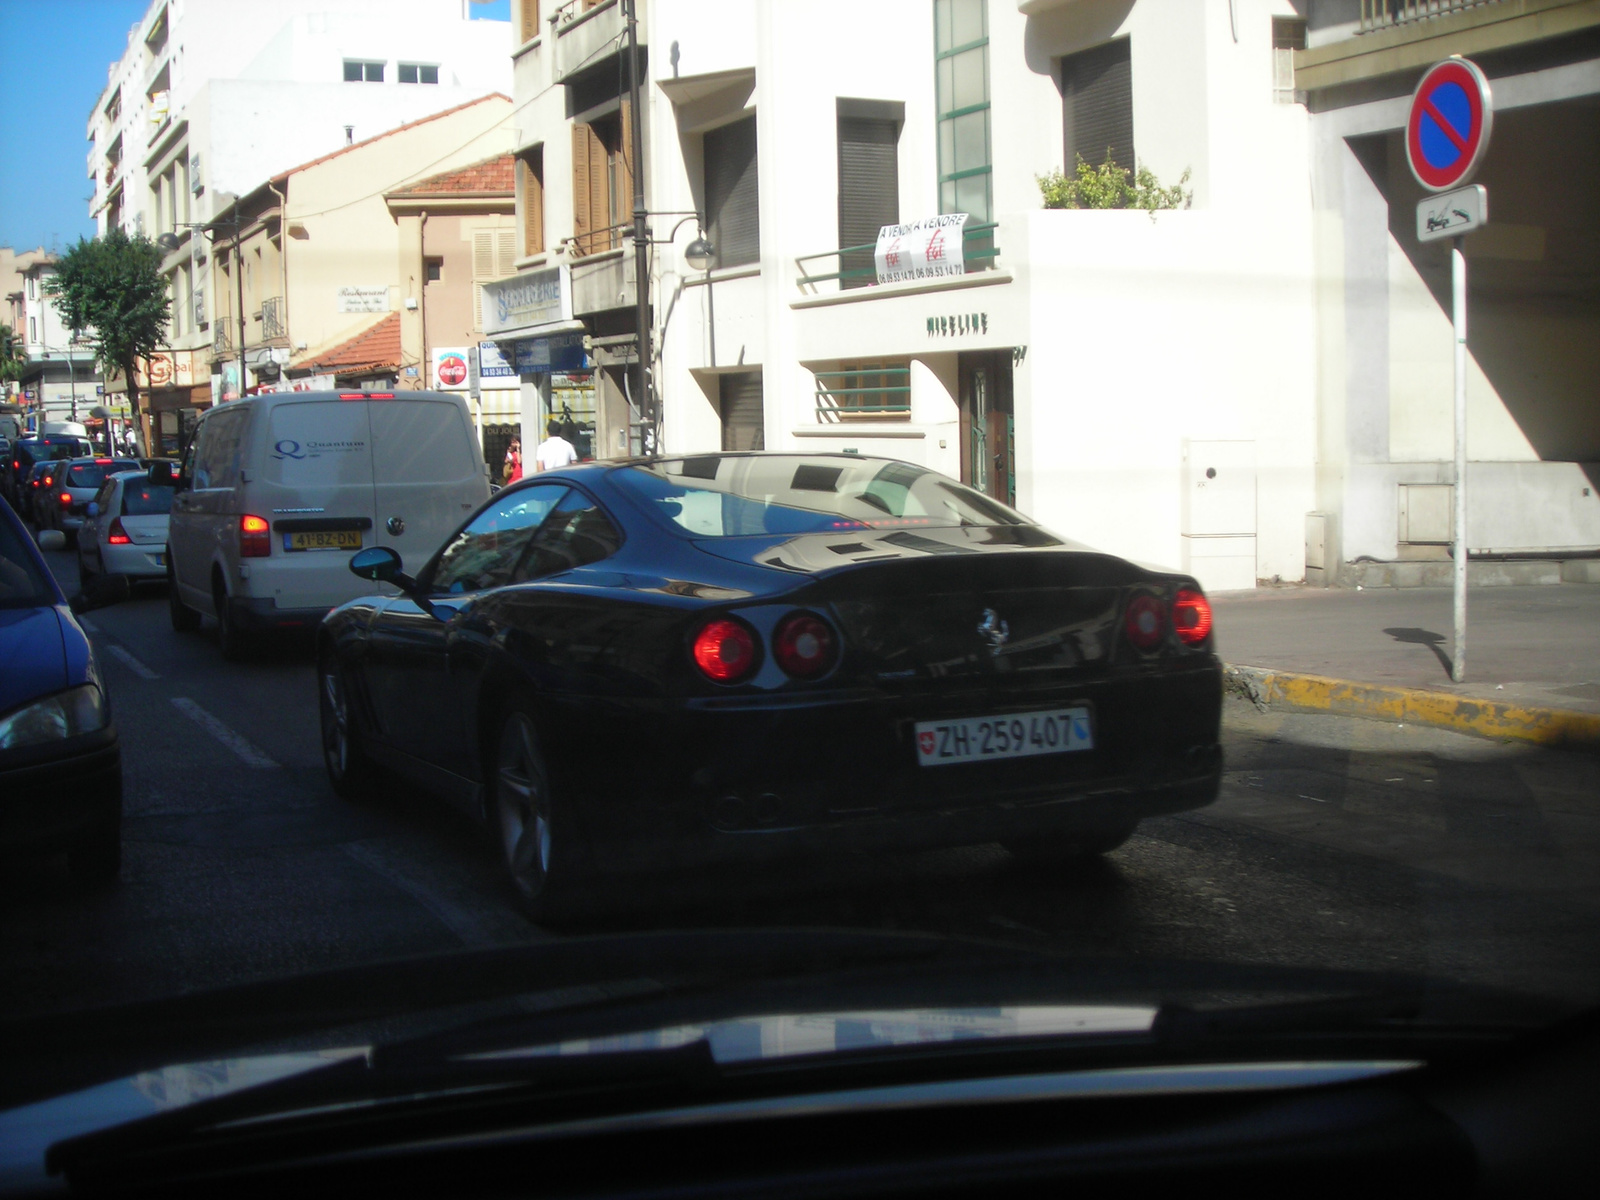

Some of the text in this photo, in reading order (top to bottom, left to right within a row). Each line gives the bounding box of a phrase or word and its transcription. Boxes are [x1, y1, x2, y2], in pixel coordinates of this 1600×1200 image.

[913, 214, 965, 230] A VENDRE
[916, 264, 963, 279] 06.09.53.14.72
[338, 287, 388, 297] Restaurant
[296, 532, 357, 546] 41-BZ-DN
